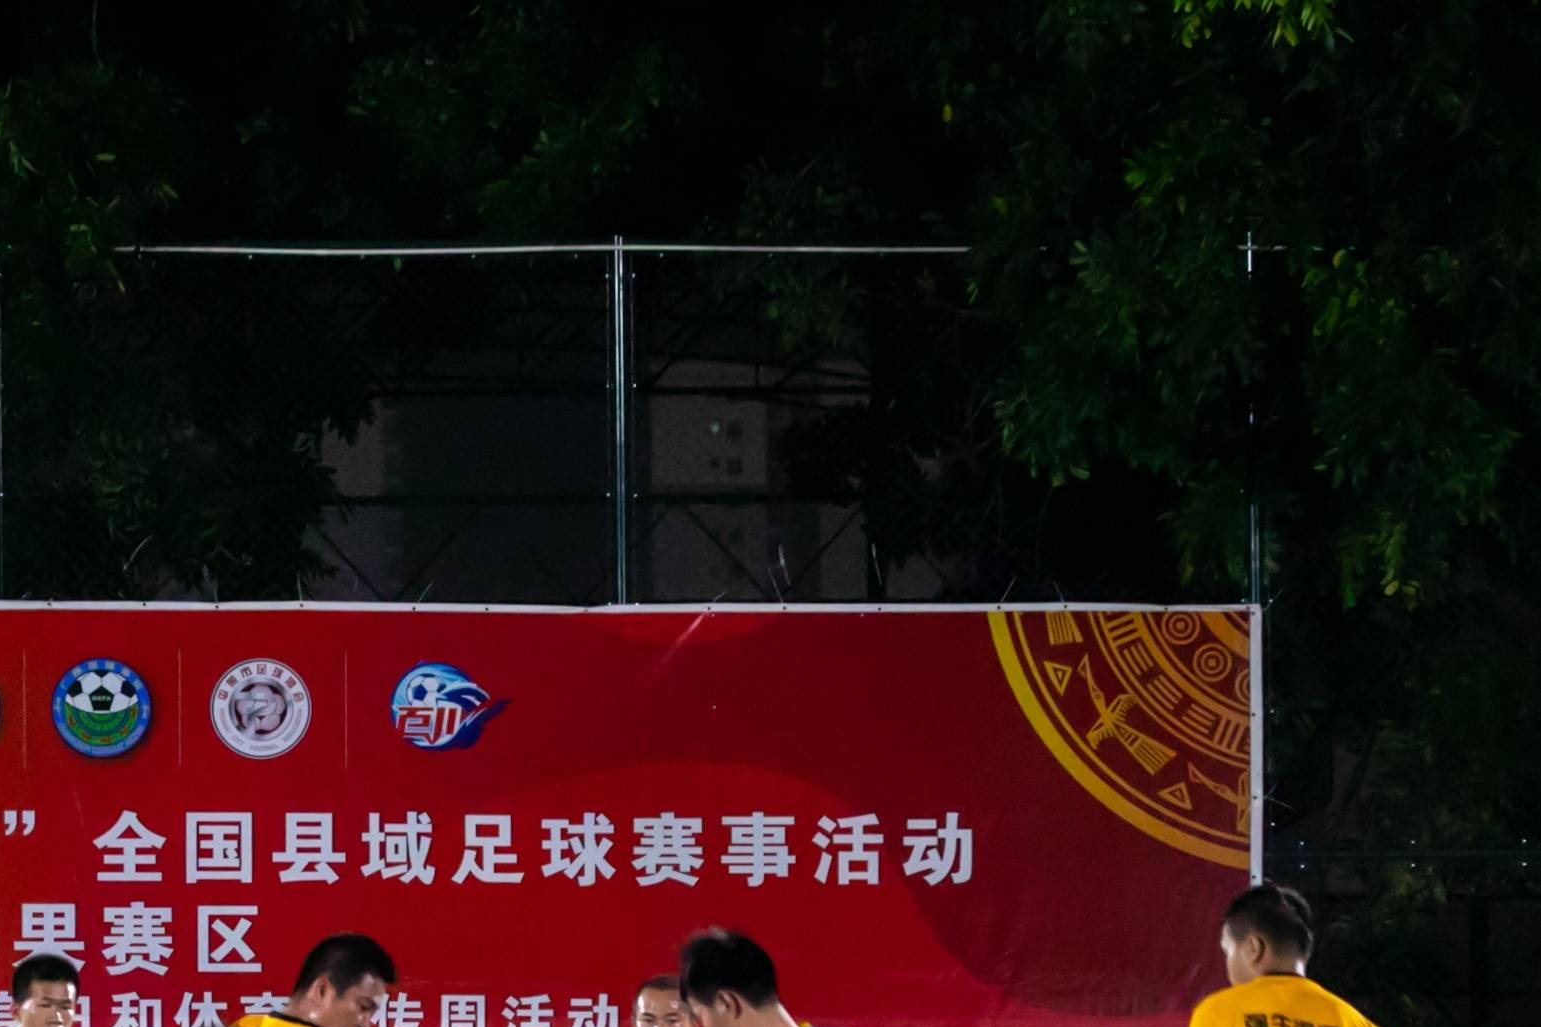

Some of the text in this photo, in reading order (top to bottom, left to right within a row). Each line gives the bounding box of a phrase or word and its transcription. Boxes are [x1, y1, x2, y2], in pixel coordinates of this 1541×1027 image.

[92, 810, 974, 887] 全国县域足球赛事活动
